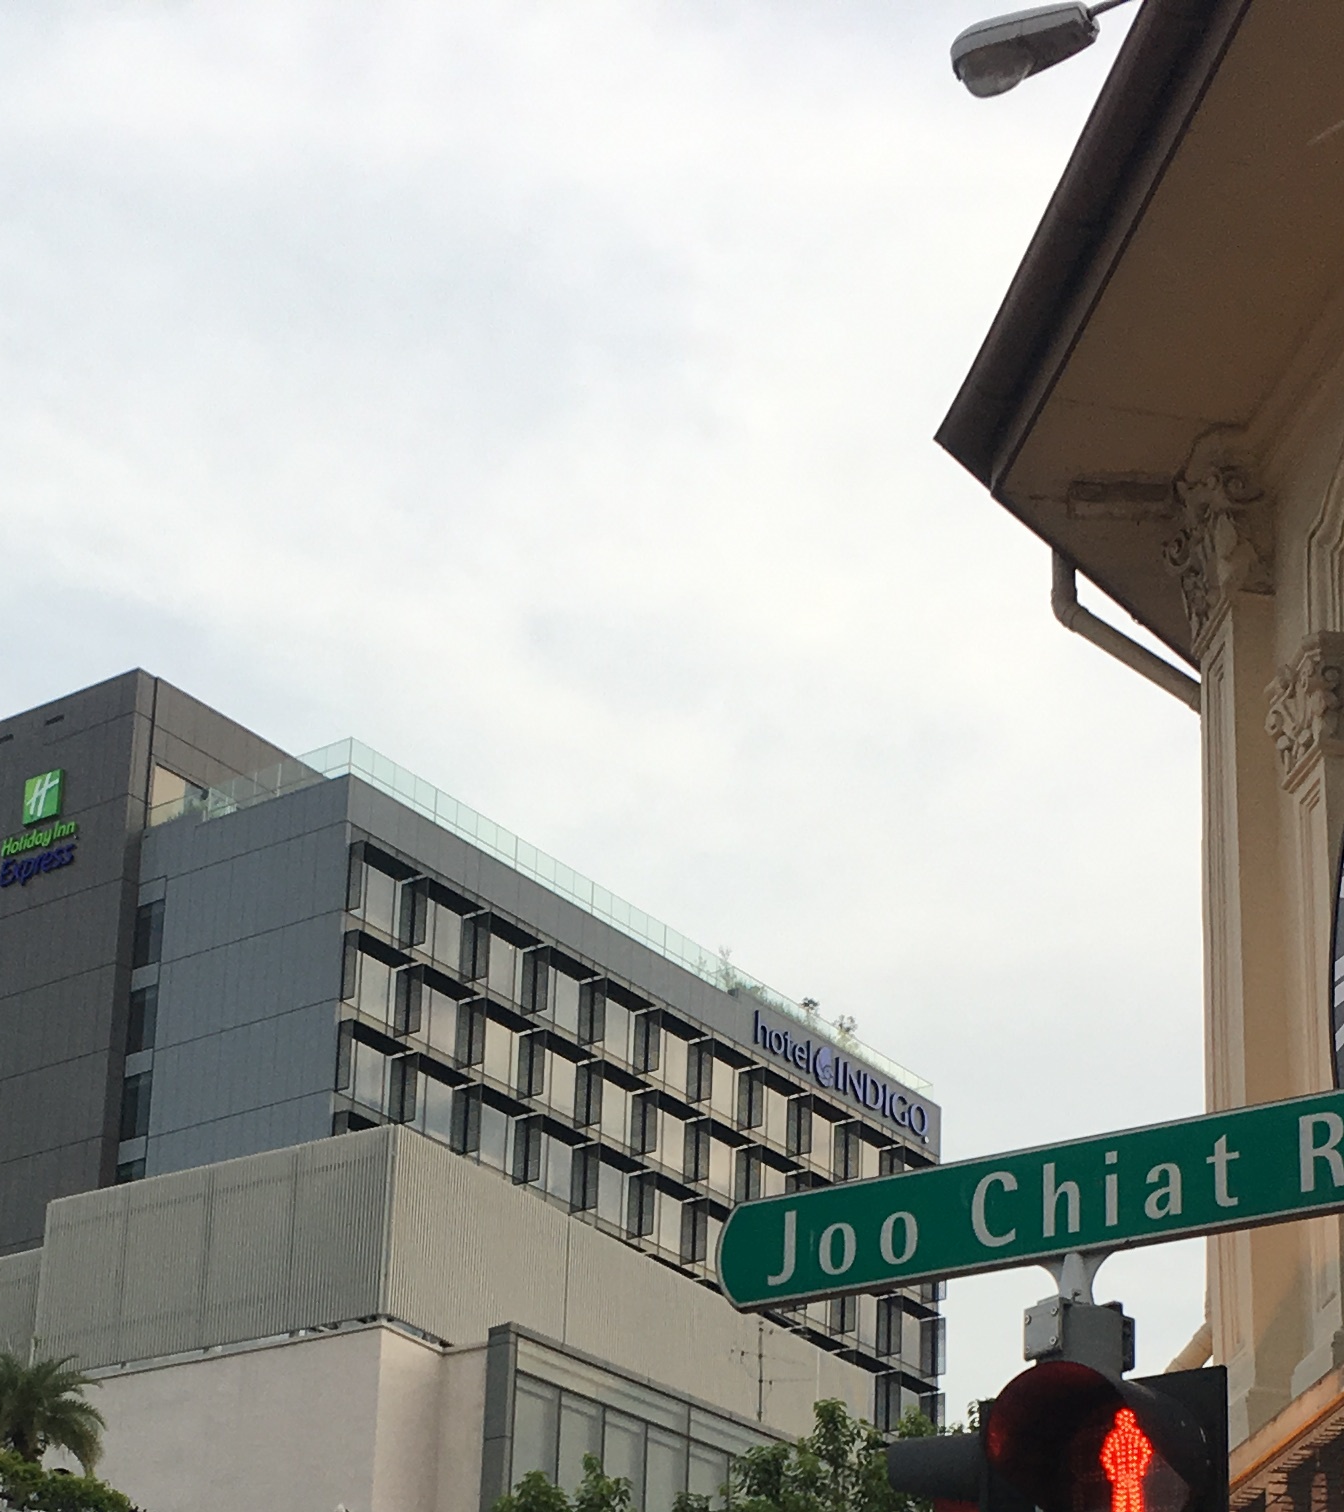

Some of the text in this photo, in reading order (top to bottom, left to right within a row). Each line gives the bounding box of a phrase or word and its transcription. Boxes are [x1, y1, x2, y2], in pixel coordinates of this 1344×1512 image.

[1, 820, 75, 857] Holiday Inn
[753, 1009, 813, 1075] hotel
[766, 1209, 919, 1287] Joo
[970, 1132, 1241, 1248] Chiat
